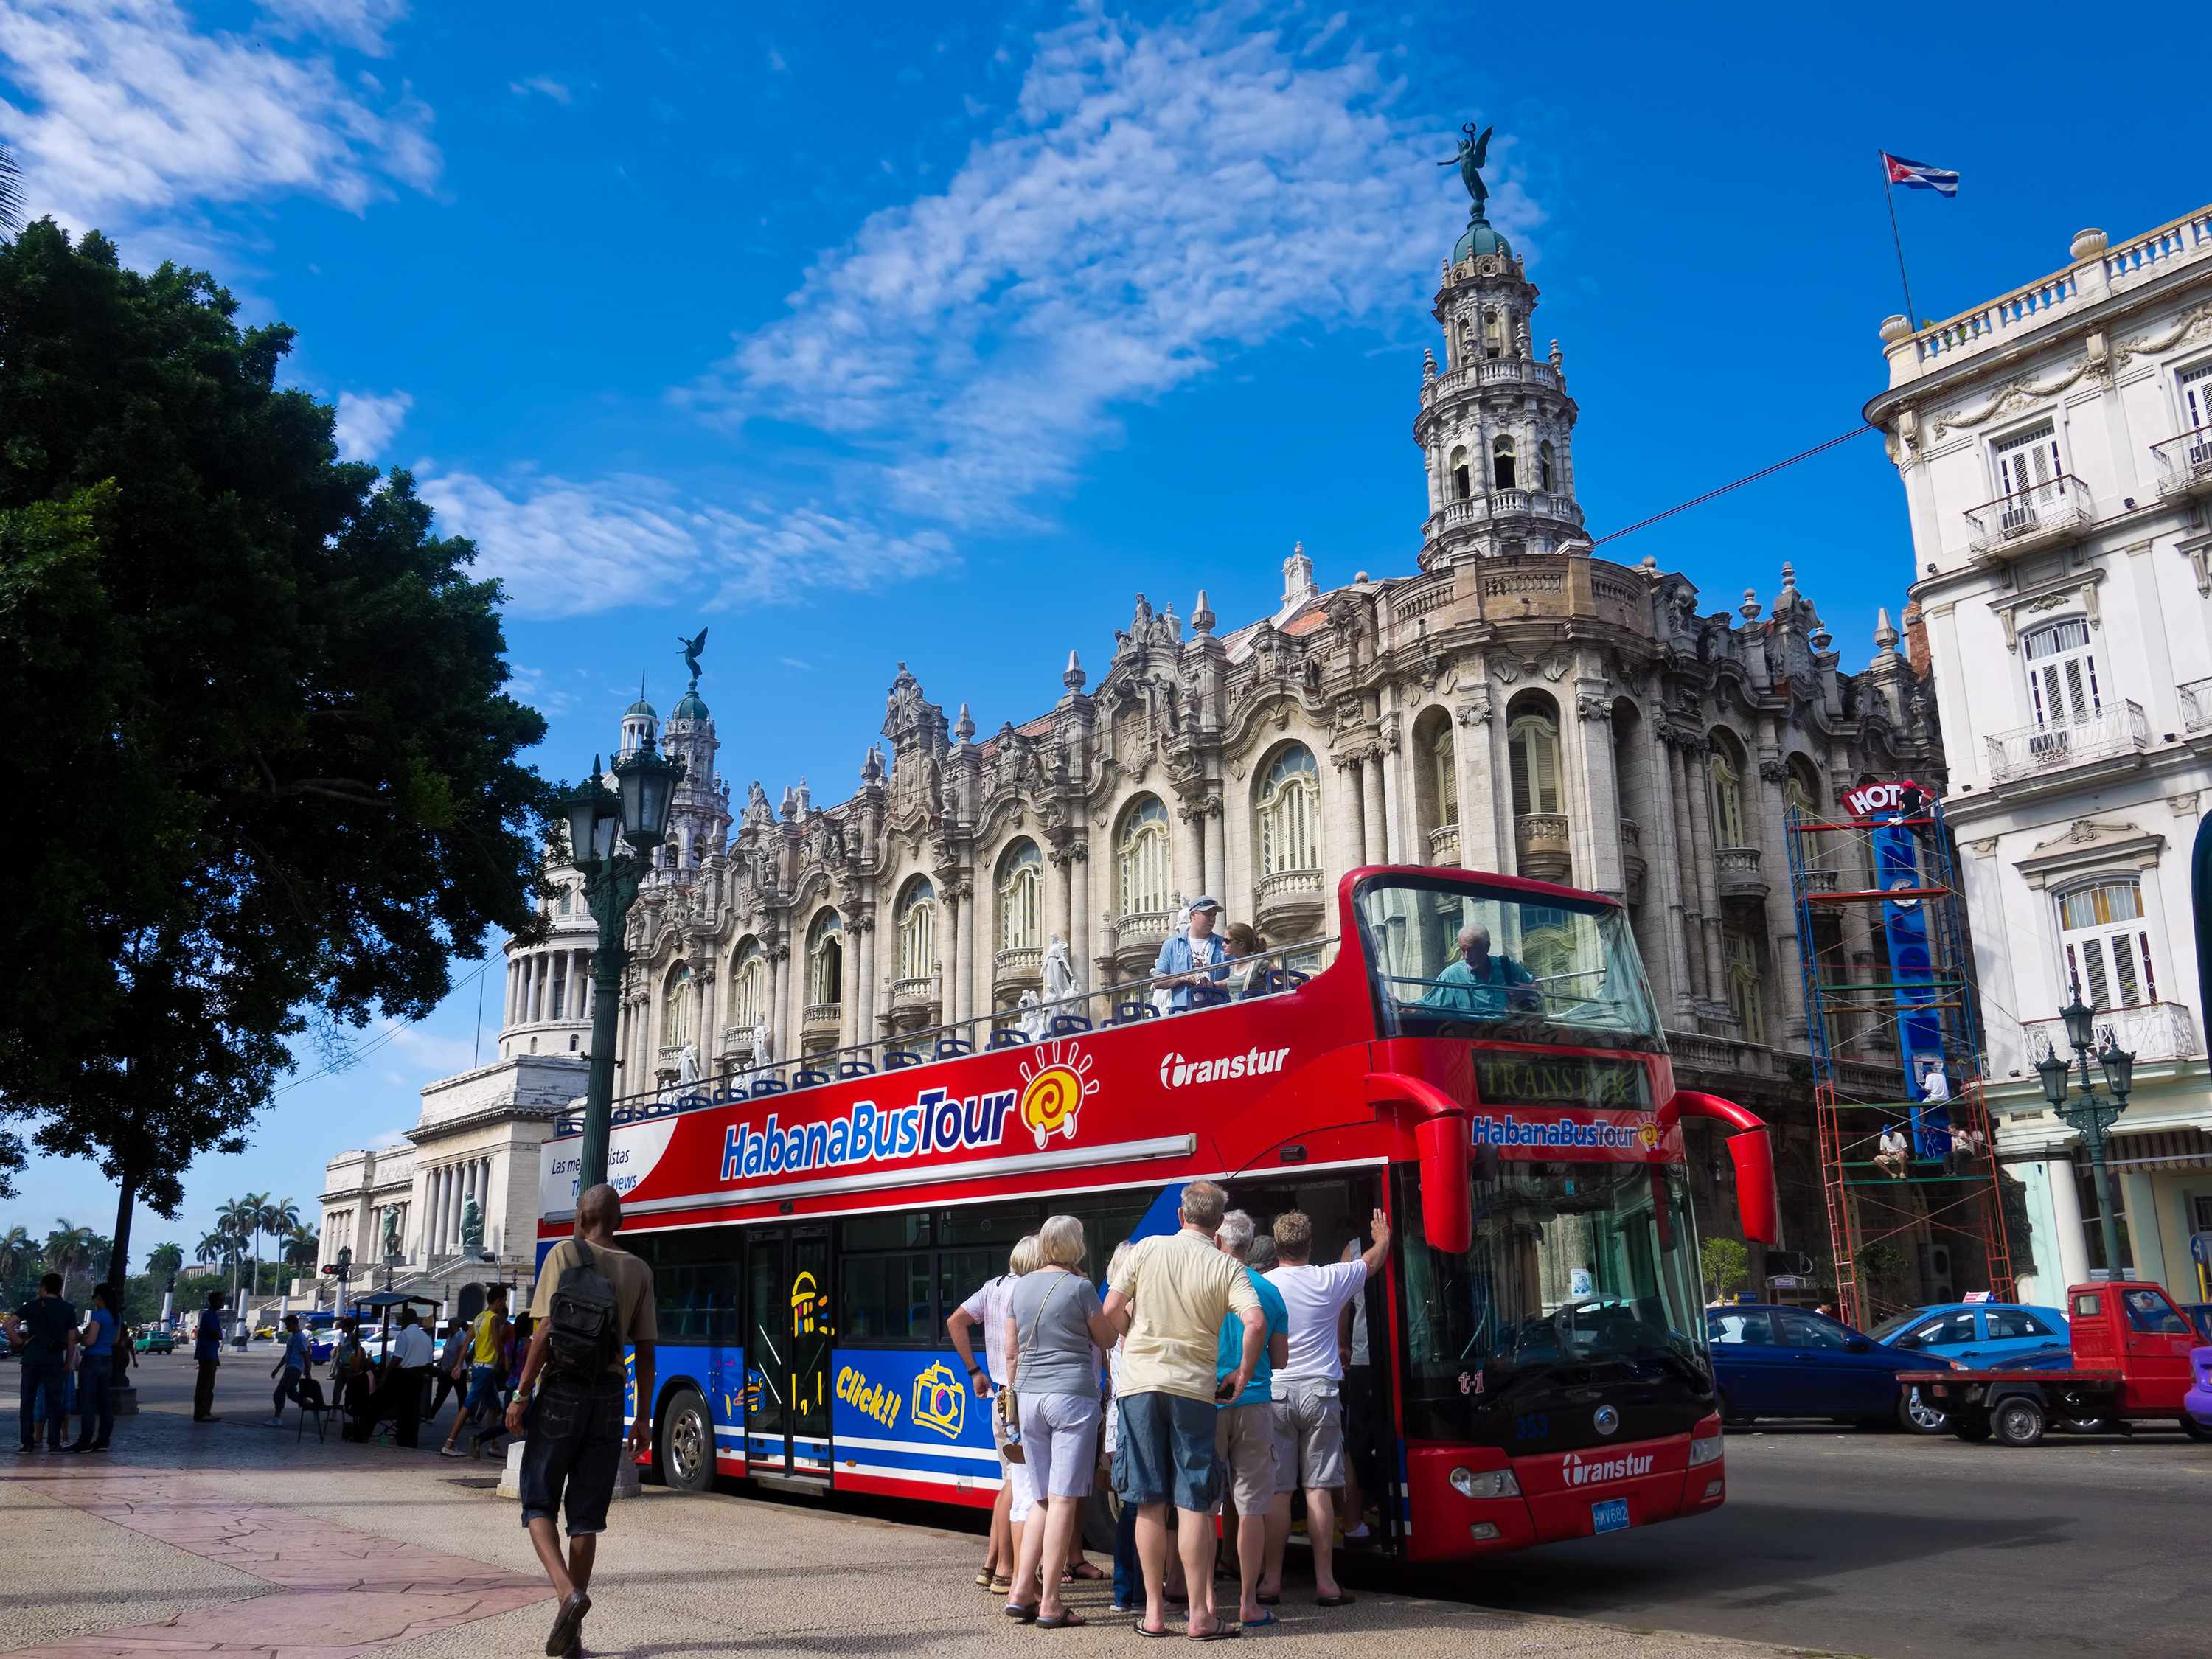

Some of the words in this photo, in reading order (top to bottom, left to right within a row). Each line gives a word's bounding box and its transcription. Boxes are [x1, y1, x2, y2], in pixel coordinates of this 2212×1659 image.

[1848, 785, 1926, 815] HOT
[721, 1087, 1017, 1180] HabanaBusTour
[1472, 1115, 1637, 1148] HabanaBusTour
[552, 1158, 566, 1175] Las
[607, 1148, 630, 1166] istas
[611, 1173, 637, 1191] views
[835, 1366, 902, 1430] Click!!
[1516, 1414, 1548, 1439] 353
[1593, 1506, 1628, 1526] HWV682
